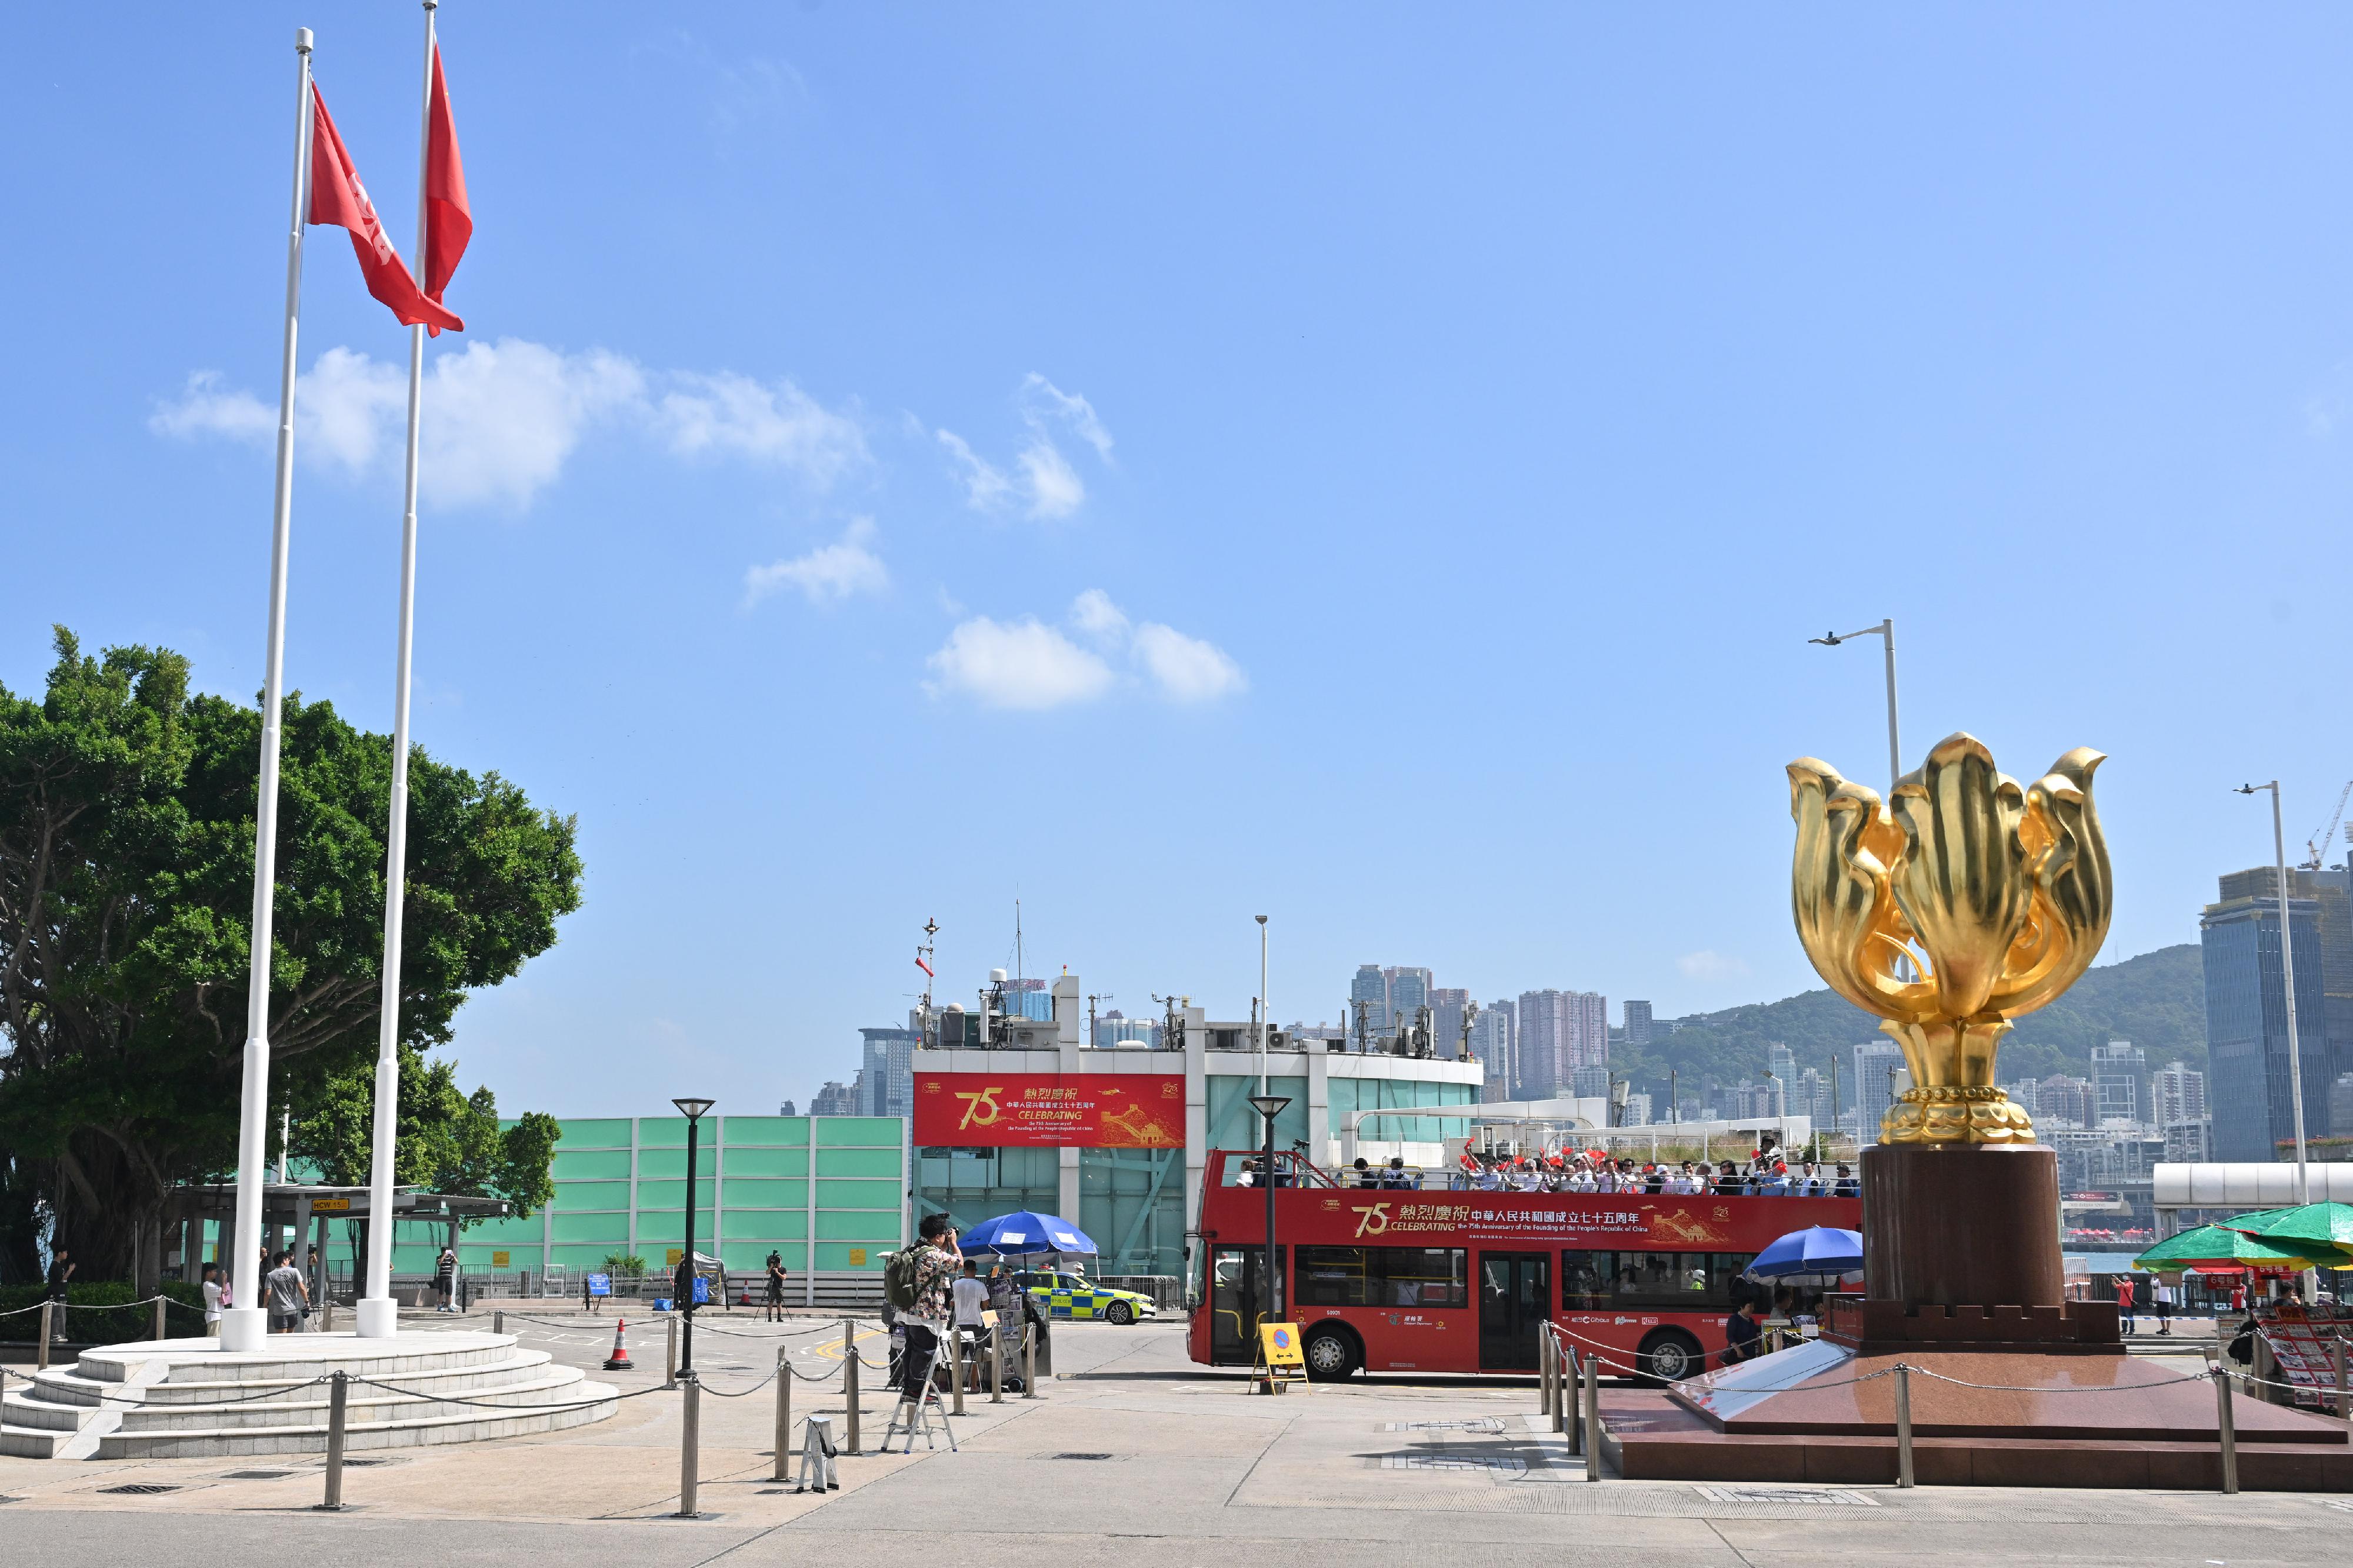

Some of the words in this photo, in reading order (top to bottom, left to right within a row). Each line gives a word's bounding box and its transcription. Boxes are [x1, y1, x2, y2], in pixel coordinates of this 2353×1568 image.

[1024, 1087, 1078, 1100] 熱烈慶祝
[954, 1087, 1004, 1130] 75
[1018, 1110, 1083, 1120] CELEBRATING
[1398, 1205, 1470, 1221] 熱烈慶祝
[1471, 1210, 1639, 1224] 中華人民共和國成立七十五周年
[1351, 1203, 1392, 1238] 75
[1391, 1222, 1456, 1232] CELEBRATING
[2211, 1276, 2235, 1285] 6号档
